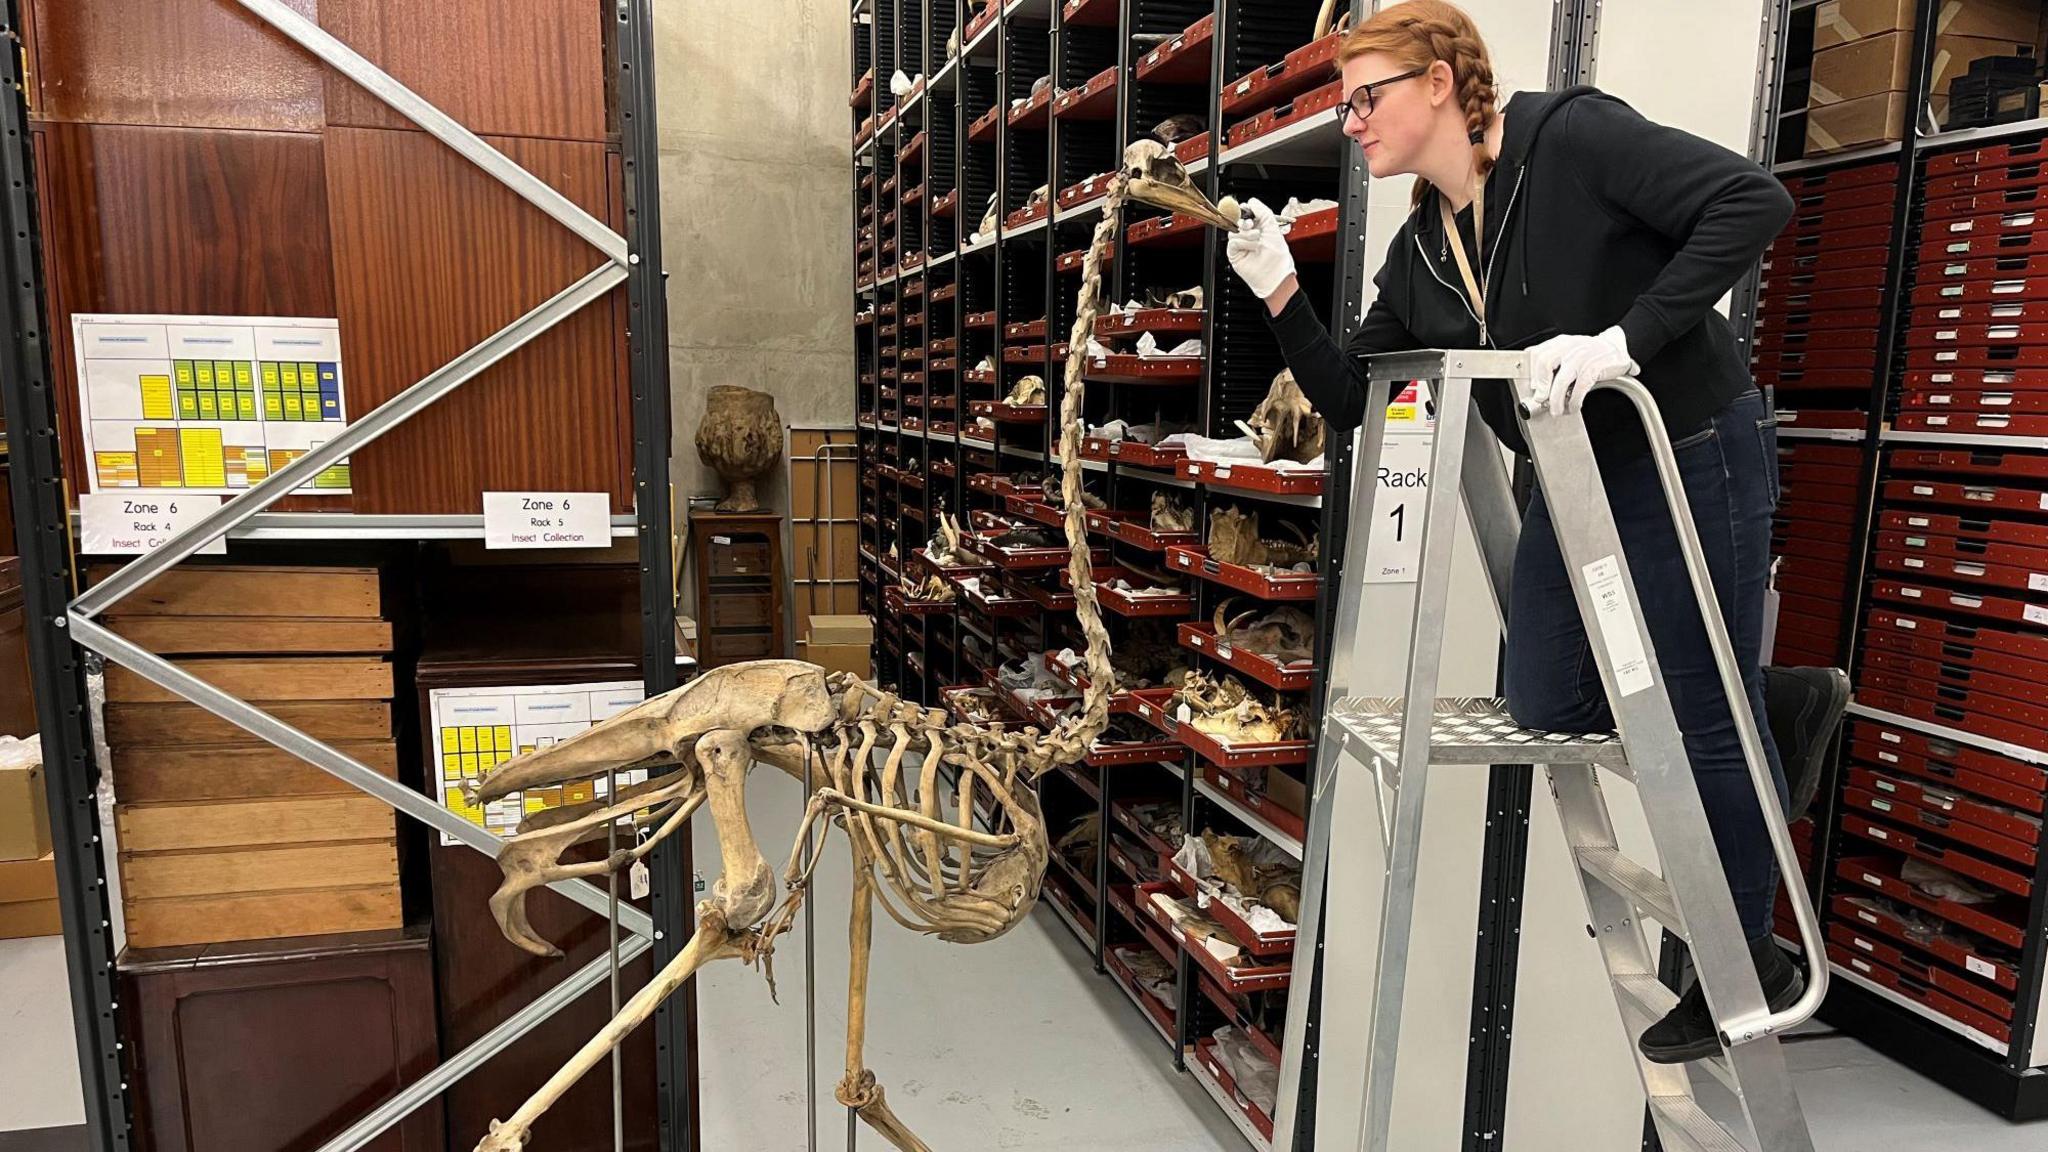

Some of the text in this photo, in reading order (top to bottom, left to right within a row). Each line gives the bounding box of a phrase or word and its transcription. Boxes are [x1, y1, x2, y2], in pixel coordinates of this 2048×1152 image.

[1377, 467, 1428, 488] Rack
[123, 500, 178, 514] Zone 6
[521, 498, 571, 510] Zone 6
[133, 521, 171, 531] Rack 4
[530, 517, 564, 527] Rack 5
[1390, 503, 1404, 542] 1
[112, 537, 141, 548] Insect
[512, 532, 585, 542] Insect Collection
[1381, 567, 1400, 575] Zone
